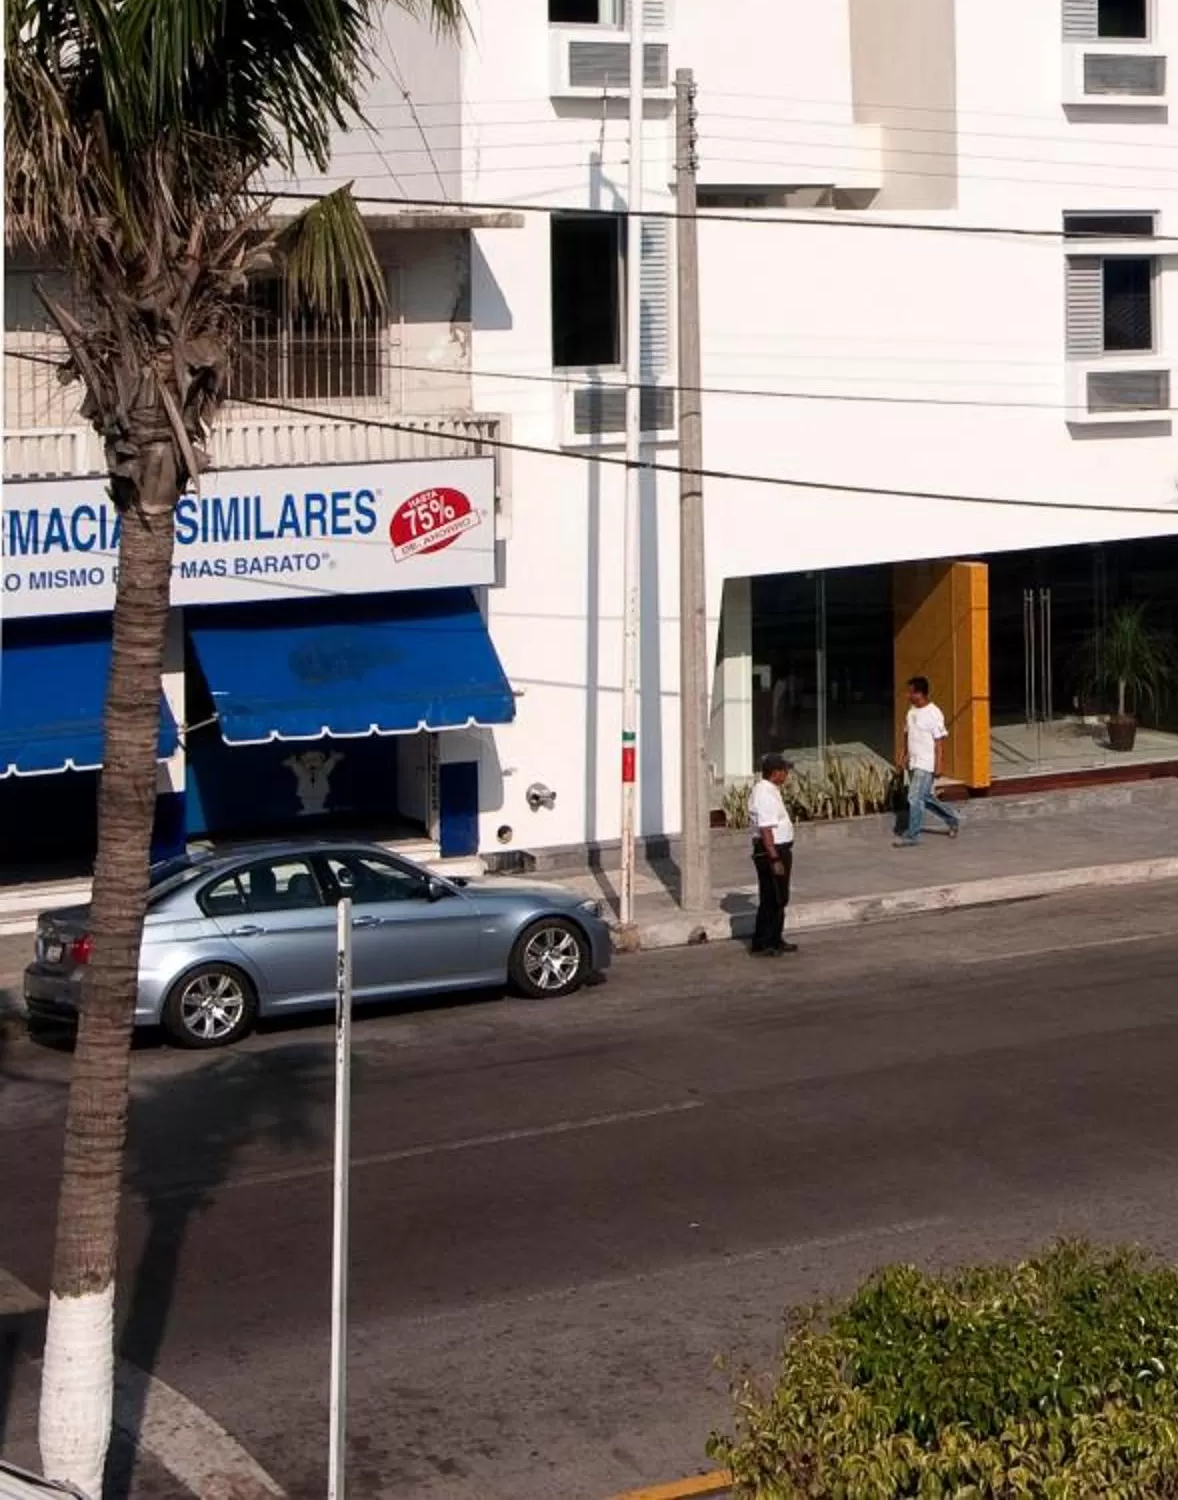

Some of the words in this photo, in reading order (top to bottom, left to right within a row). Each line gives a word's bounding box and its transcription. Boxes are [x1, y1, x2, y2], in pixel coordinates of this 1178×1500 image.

[175, 489, 378, 545] SIMILARES
[401, 494, 456, 537] 75%
[1, 572, 22, 593] O
[29, 566, 105, 590] MISMO
[180, 558, 228, 579] MAS
